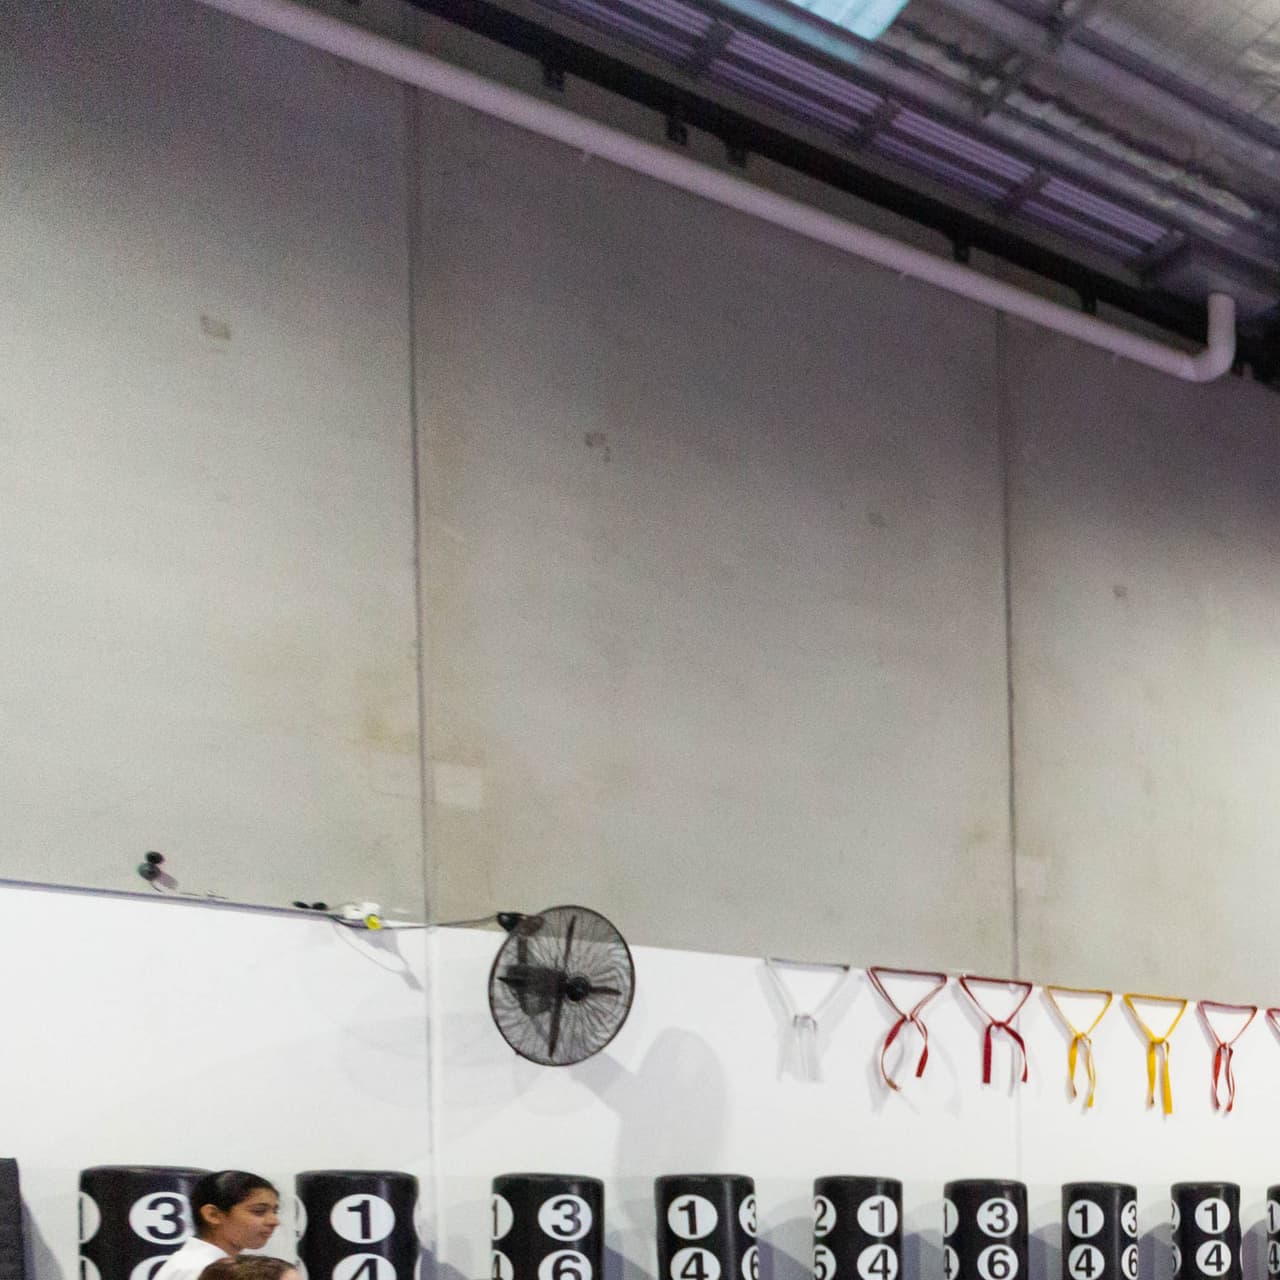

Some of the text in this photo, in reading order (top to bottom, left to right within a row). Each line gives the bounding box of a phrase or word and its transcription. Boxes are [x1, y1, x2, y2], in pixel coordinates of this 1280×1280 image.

[146, 1196, 185, 1240] 3
[347, 1200, 372, 1240] 1
[552, 1199, 582, 1237] 3
[678, 1200, 699, 1235] 1
[814, 1199, 828, 1231] 2
[869, 1200, 885, 1233] 1
[986, 1203, 1011, 1233] 3
[1075, 1204, 1088, 1234] 1
[1127, 1204, 1137, 1234] 3
[1204, 1202, 1218, 1231] 1
[1267, 1204, 1275, 1232] 1
[868, 1249, 892, 1280] 4
[986, 1249, 1011, 1280] 6
[1074, 1248, 1096, 1278] 4
[1128, 1248, 1138, 1277] 6
[1204, 1244, 1225, 1272] 4
[1268, 1245, 1280, 1271] 4
